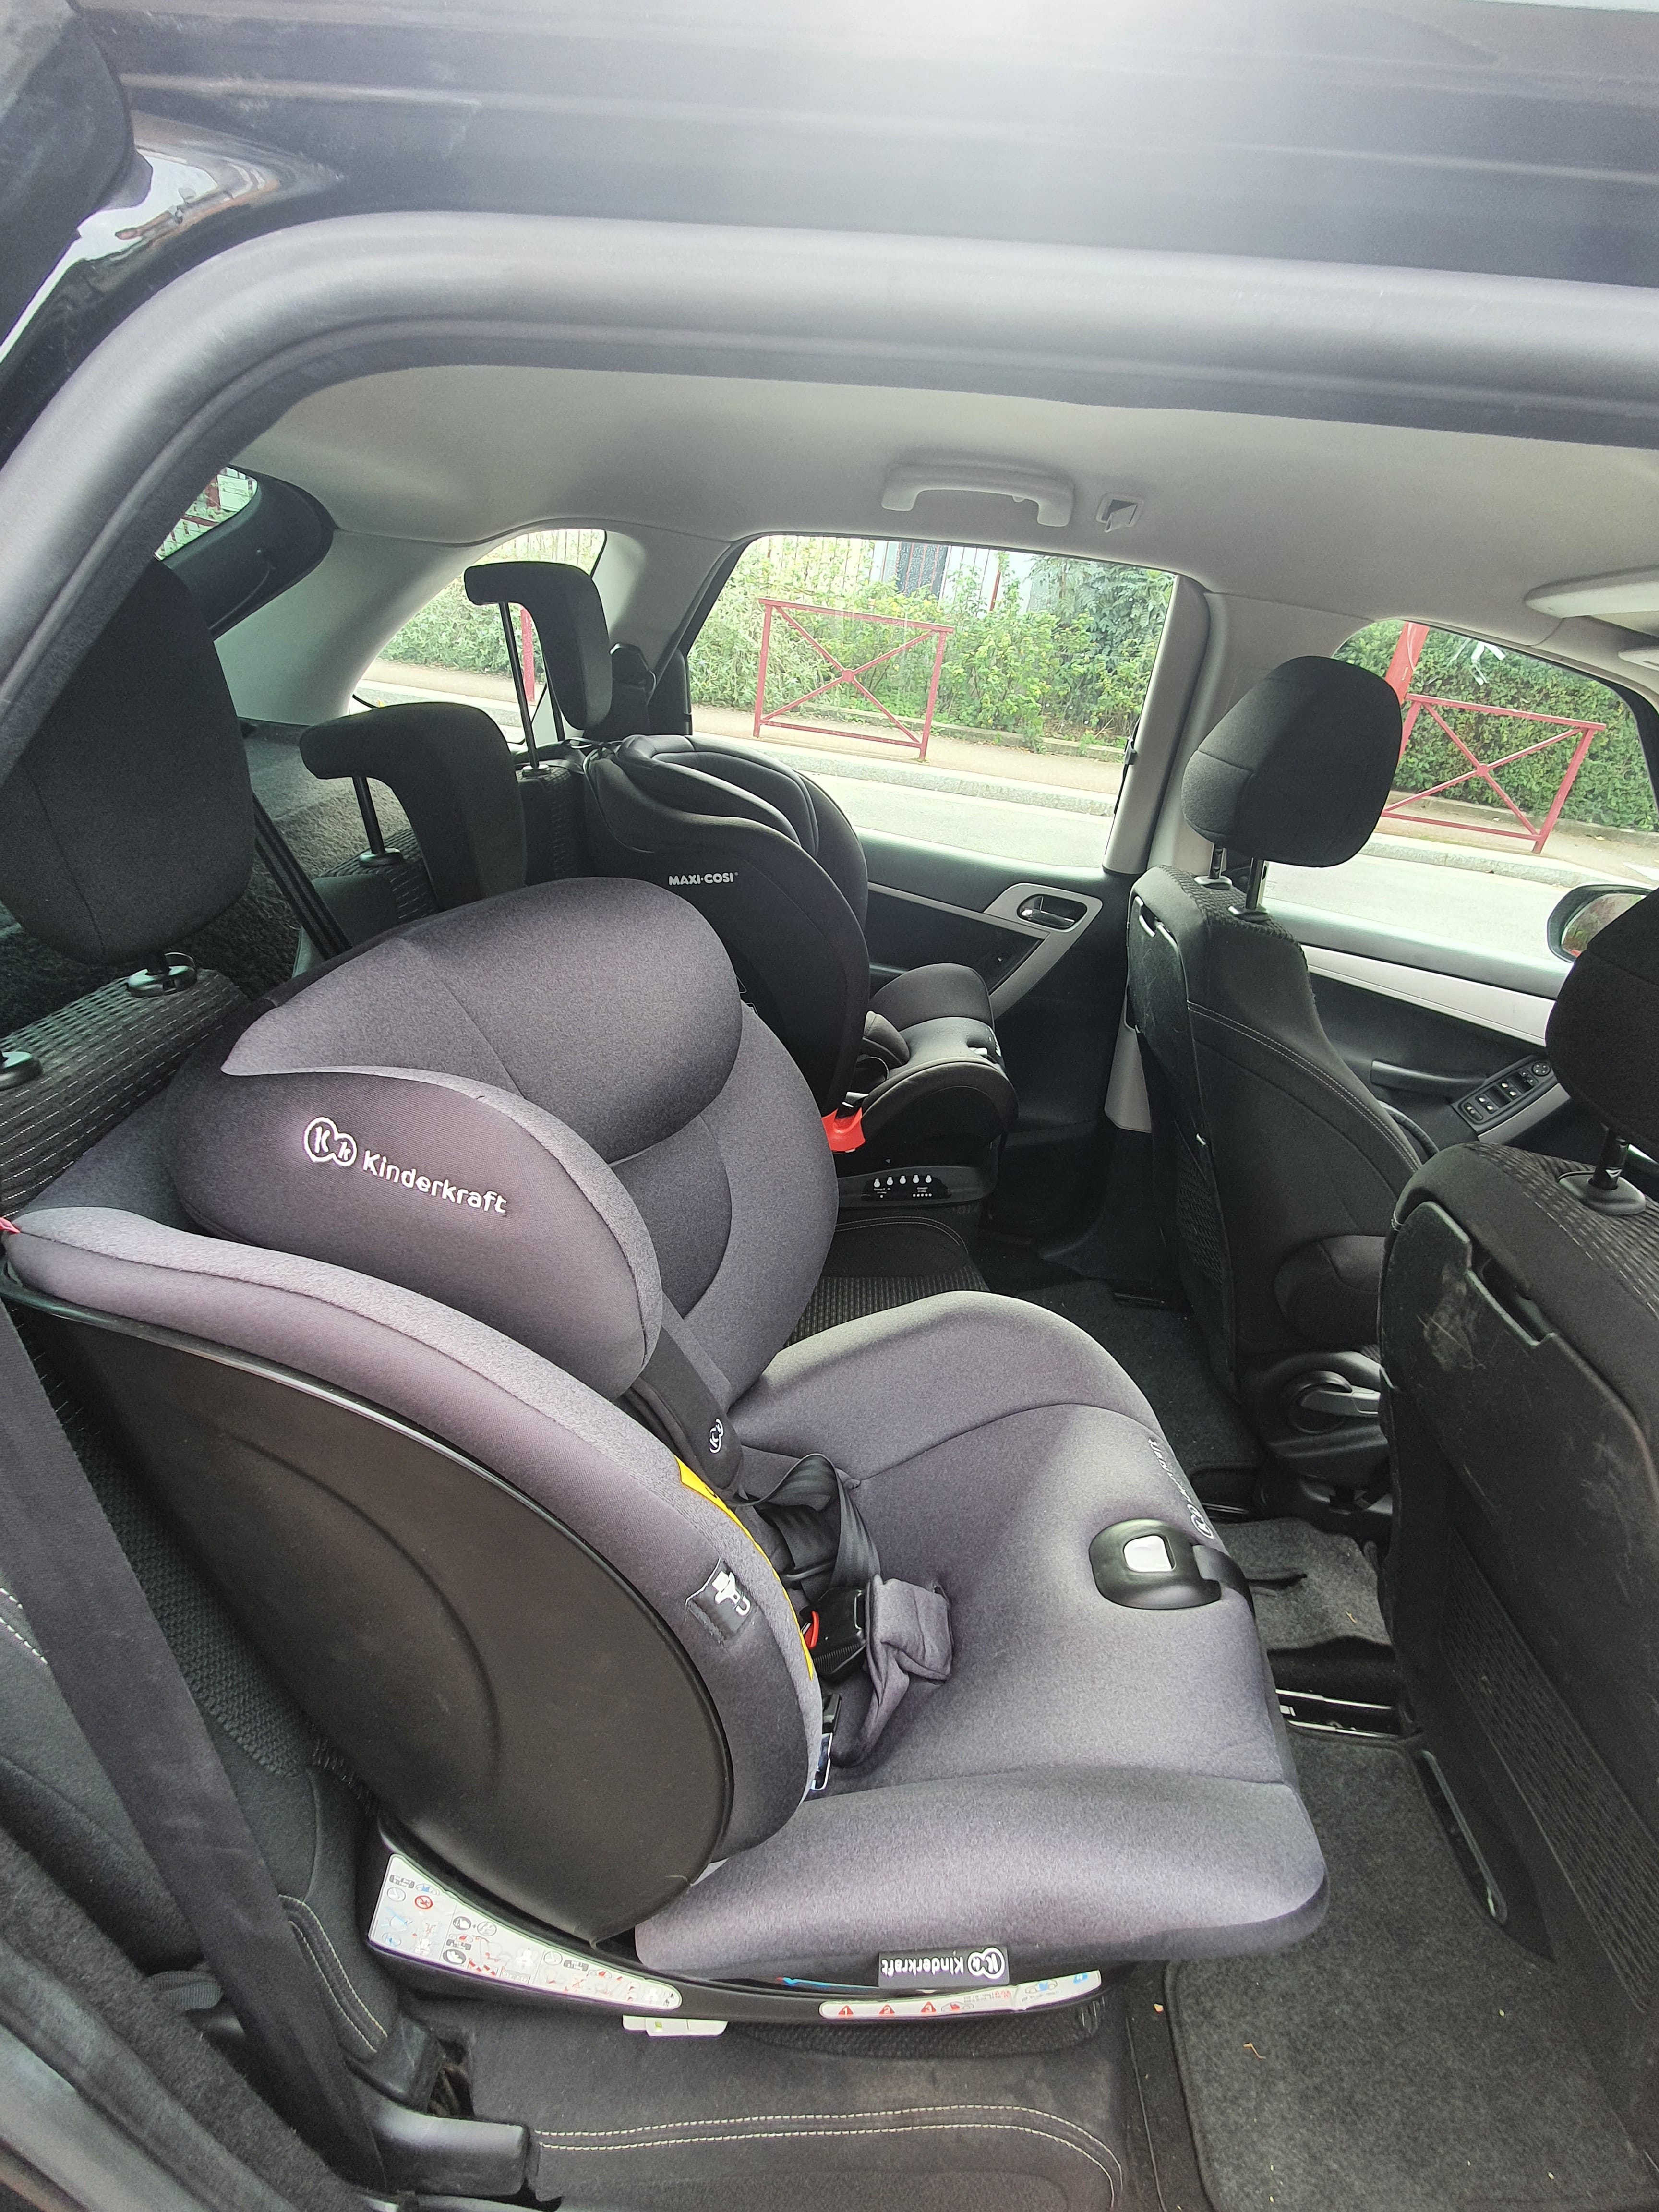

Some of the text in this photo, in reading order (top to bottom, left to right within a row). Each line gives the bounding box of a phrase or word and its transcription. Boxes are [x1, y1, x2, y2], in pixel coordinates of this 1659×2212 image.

[362, 1149, 507, 1214] Kinderkraft
[881, 1956, 964, 1977] Kinderkraft
[883, 2006, 891, 2014] 2
[925, 2004, 932, 2012] 3
